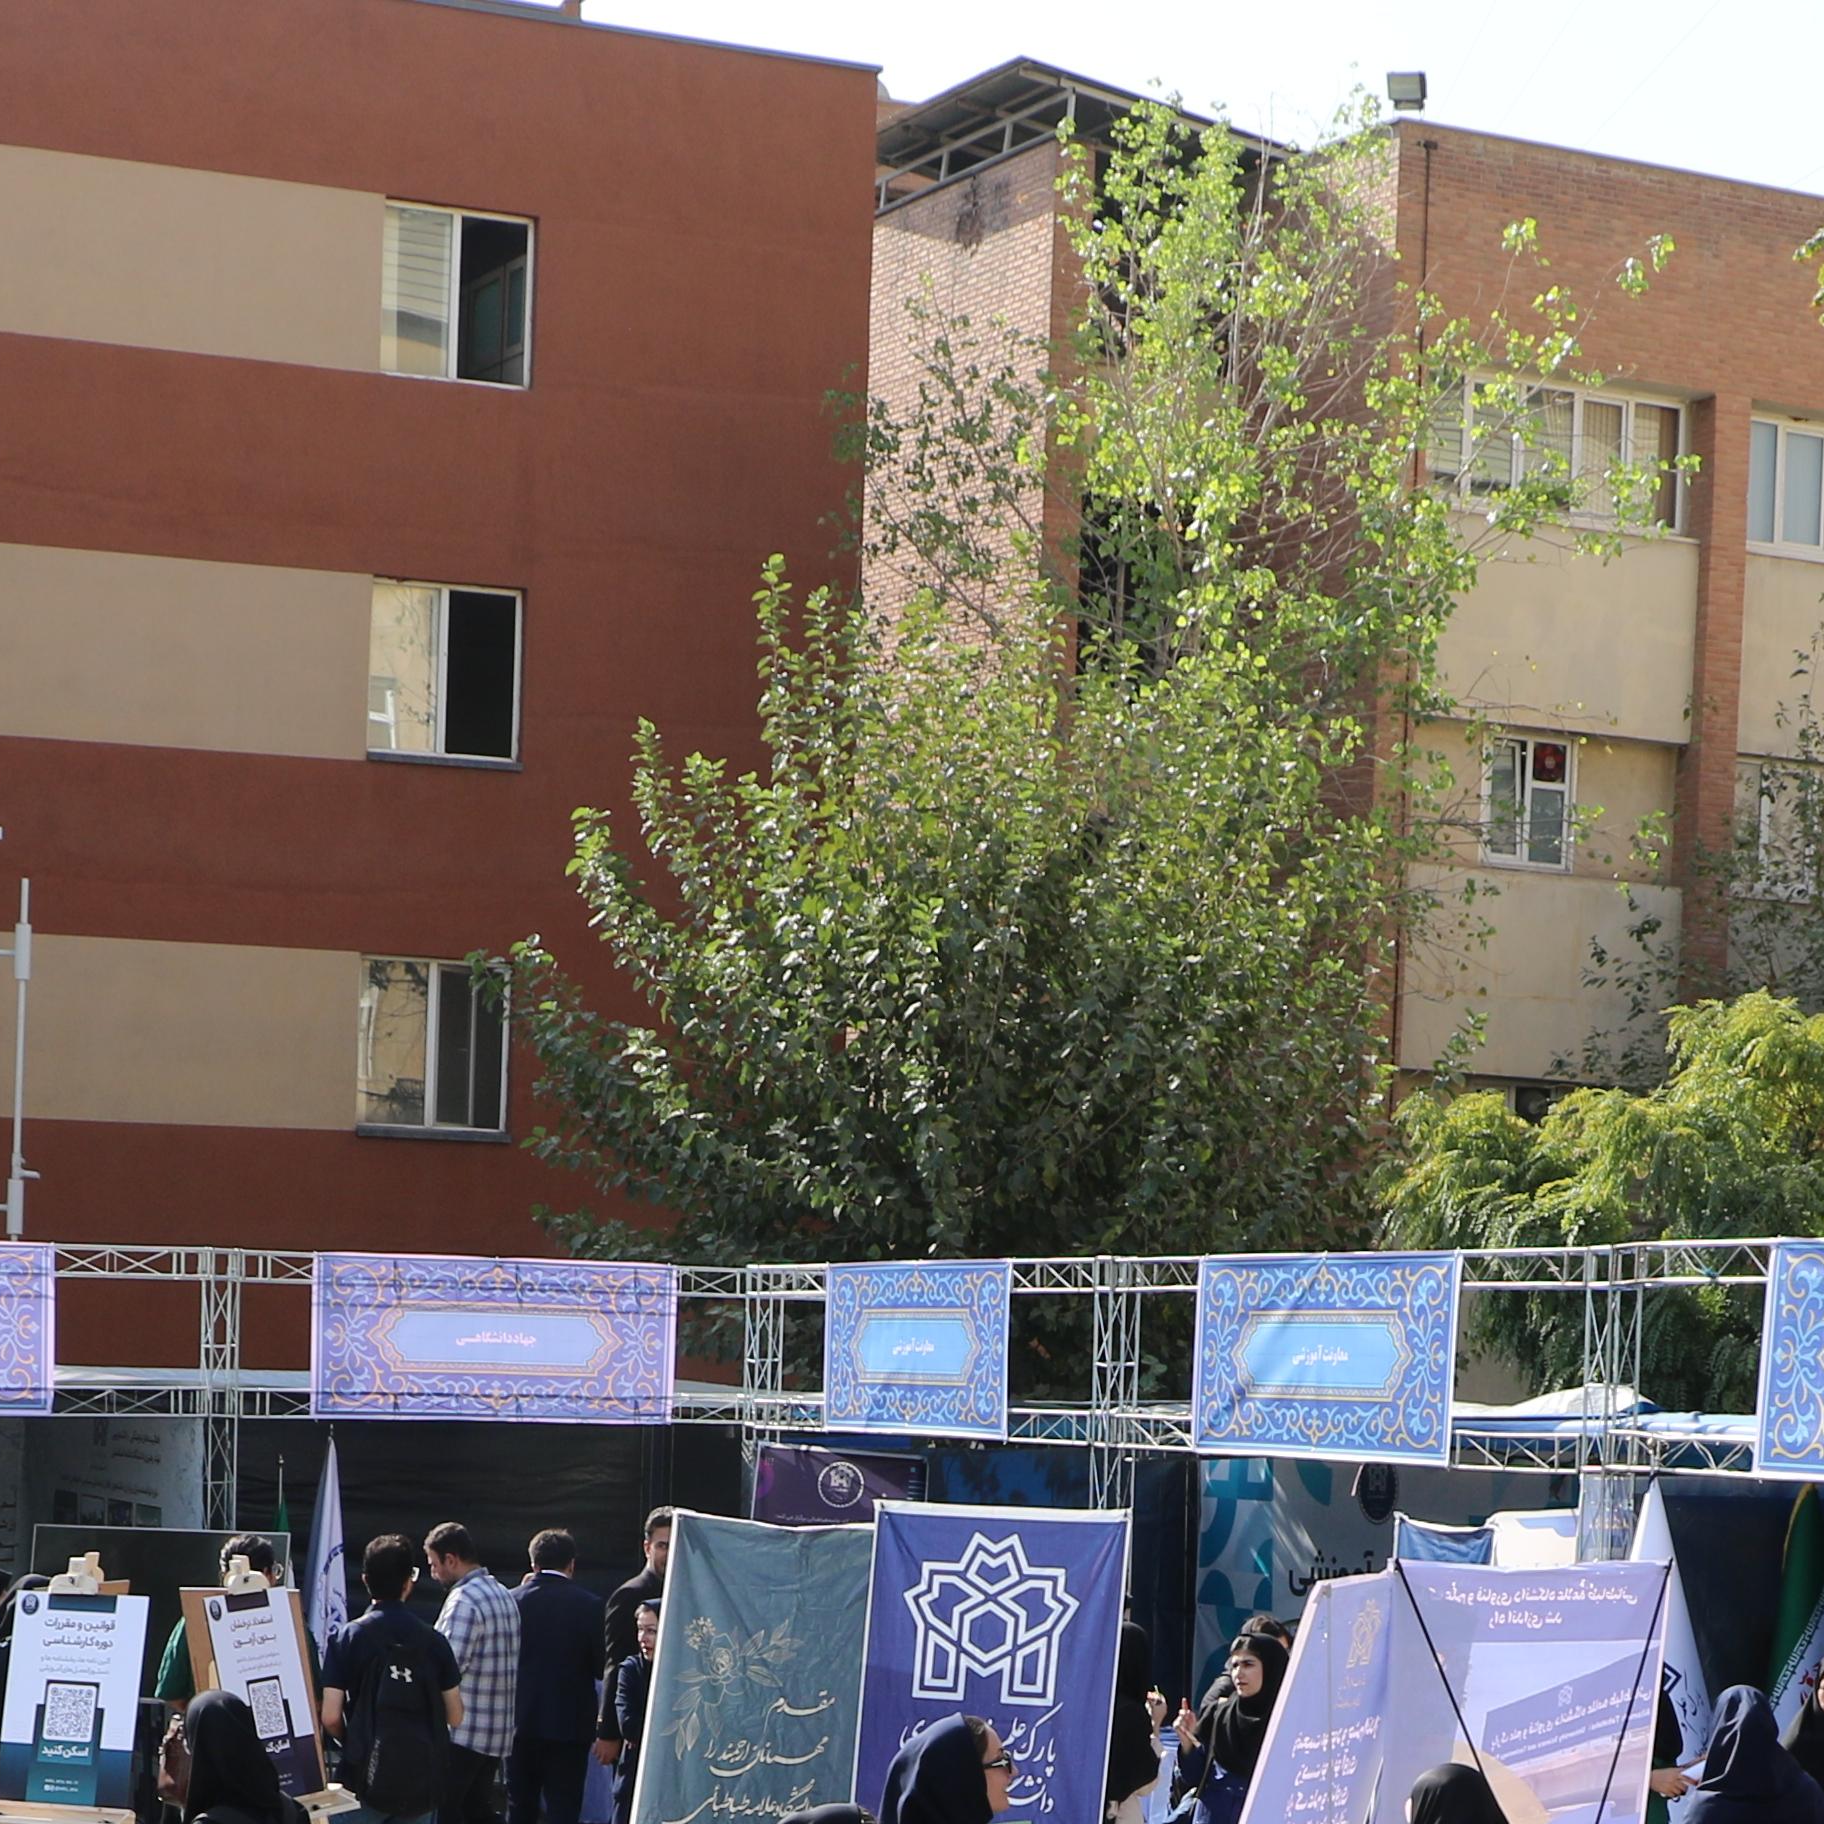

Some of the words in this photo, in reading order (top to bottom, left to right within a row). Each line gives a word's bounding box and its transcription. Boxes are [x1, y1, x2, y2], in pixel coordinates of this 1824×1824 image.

[512, 1331, 537, 1348] جهاد
[1291, 1345, 1324, 1367] آموزشی
[1324, 1346, 1350, 1367] معاونت
[44, 1616, 76, 1631] مقررات
[83, 1618, 116, 1633] قوانین
[42, 1634, 96, 1649] کارشناسی
[95, 1639, 114, 1650] دوره
[40, 1744, 64, 1758] کنید
[63, 1745, 90, 1759] اسکن
